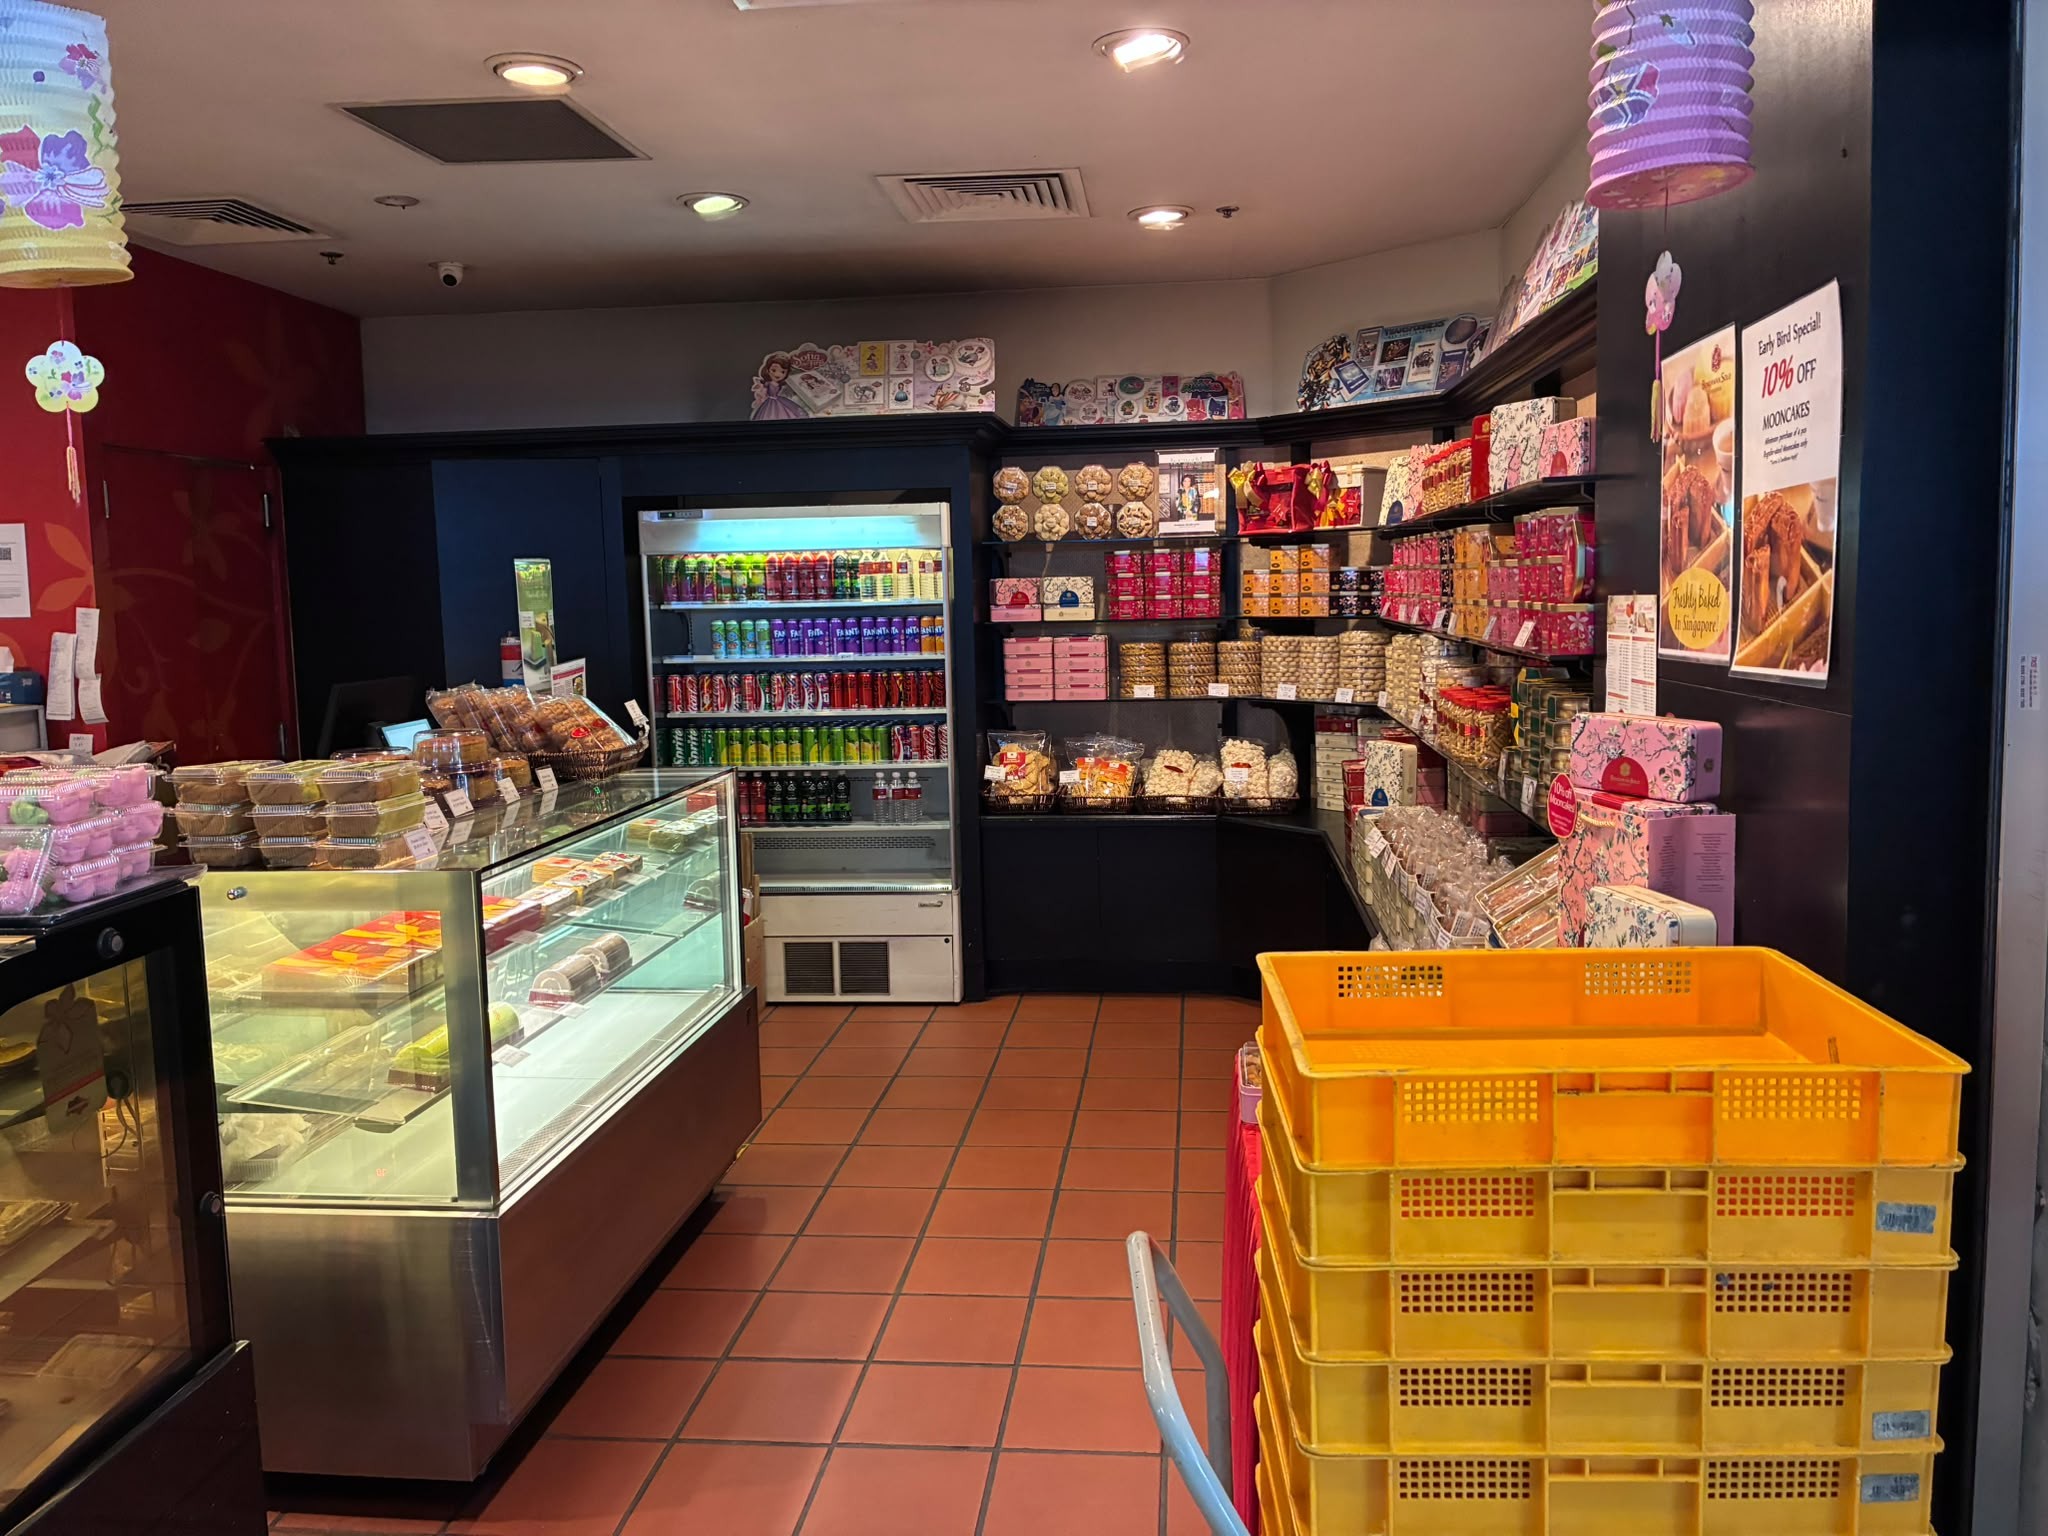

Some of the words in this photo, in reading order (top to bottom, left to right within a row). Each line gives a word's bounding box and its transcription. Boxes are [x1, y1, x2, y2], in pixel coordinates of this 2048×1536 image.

[1758, 334, 1775, 356] Early
[1776, 325, 1791, 347] Bird
[1792, 312, 1821, 342] Special!
[1761, 354, 1794, 399] 10%
[1796, 358, 1817, 384] OFF
[1762, 400, 1810, 431] MOONCAKES
[1673, 582, 1697, 618] Freshly
[1698, 583, 1721, 610] Baked
[1674, 614, 1681, 630] In
[1682, 614, 1719, 639] Singapore!
[673, 728, 686, 765] Sprite
[687, 728, 700, 765] Sprite
